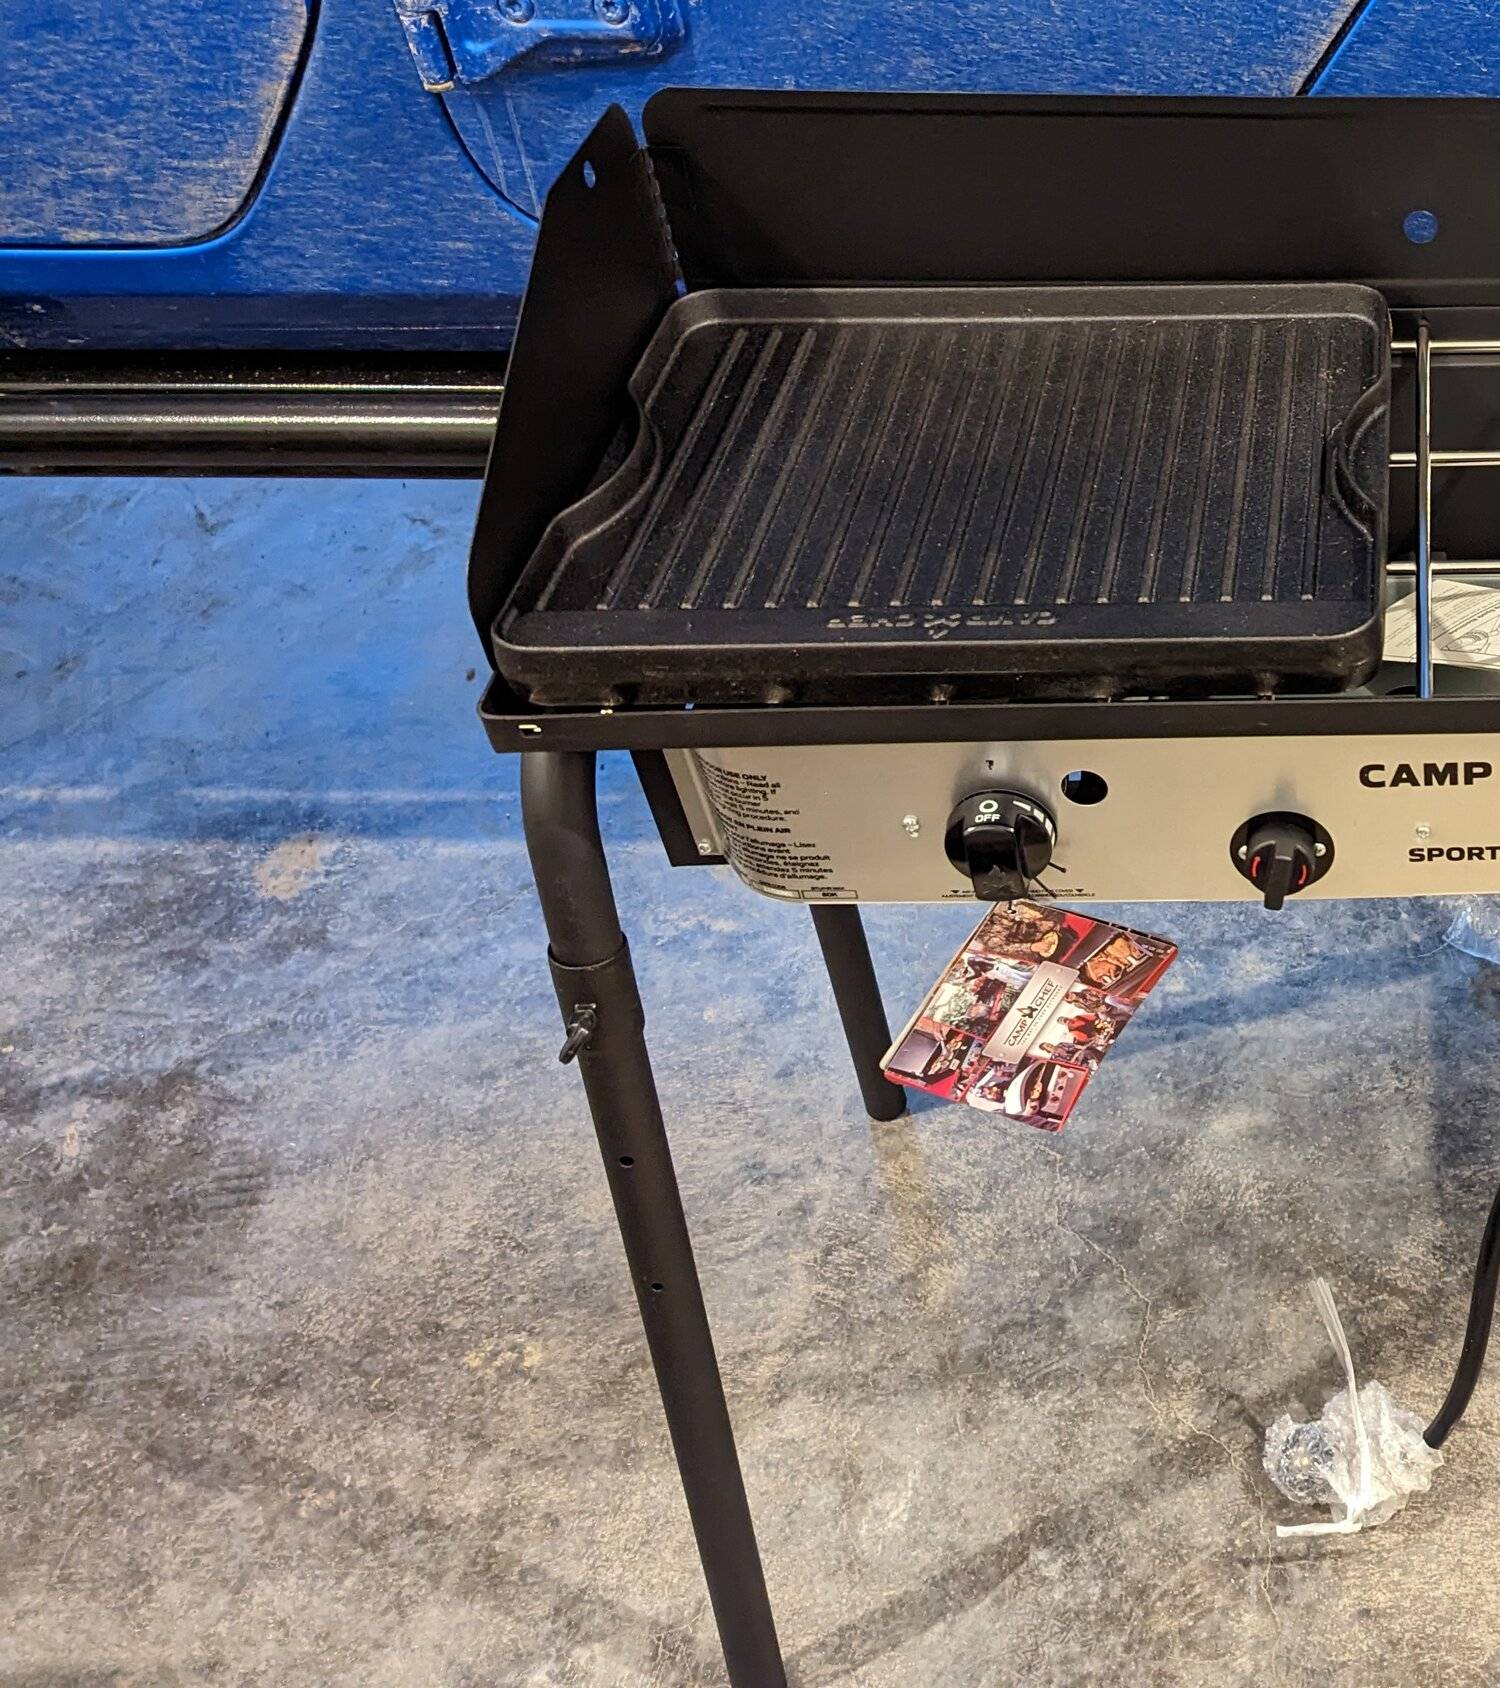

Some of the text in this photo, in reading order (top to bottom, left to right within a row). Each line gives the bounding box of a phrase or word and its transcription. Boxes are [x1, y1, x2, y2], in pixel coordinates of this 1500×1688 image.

[1359, 761, 1493, 788] CAMP
[975, 814, 1001, 823] OFF
[1008, 1019, 1028, 1047] CAMP
[1034, 980, 1055, 1008] CHEF
